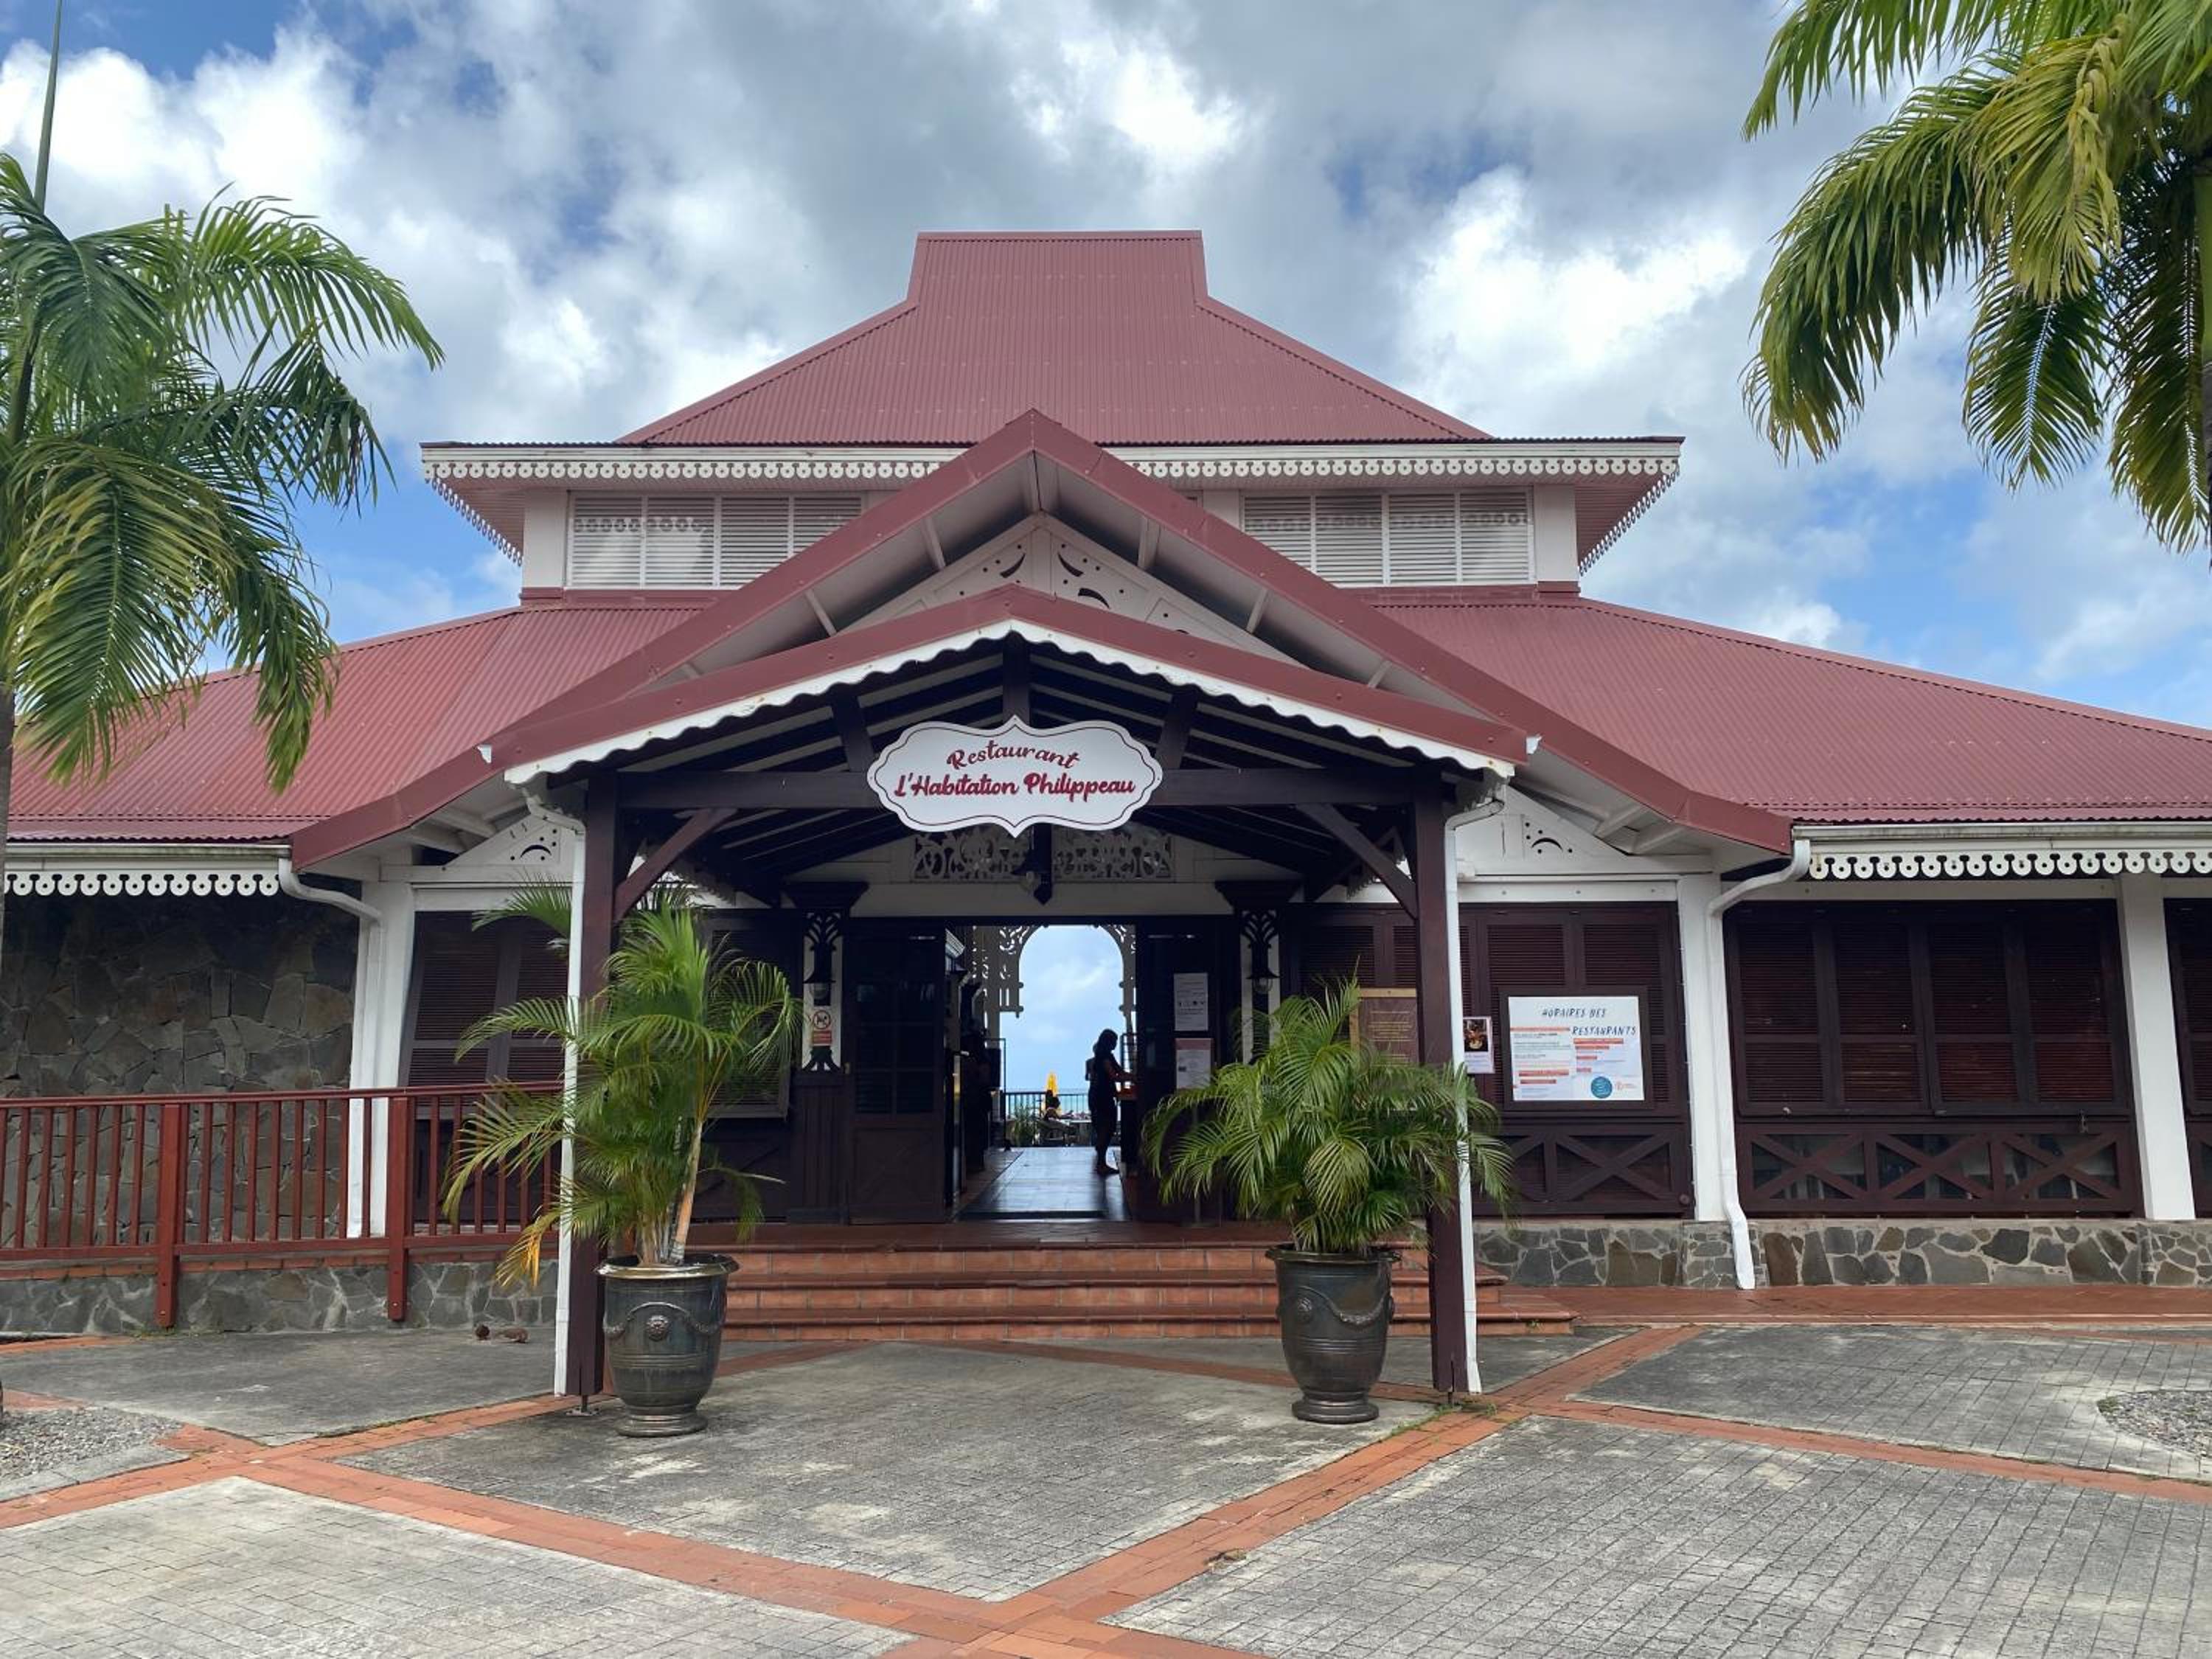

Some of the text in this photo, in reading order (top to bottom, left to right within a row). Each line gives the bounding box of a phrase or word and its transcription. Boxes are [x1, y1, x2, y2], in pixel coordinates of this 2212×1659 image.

[947, 740, 1080, 770] Restaurant
[894, 772, 1136, 803] L'Habitation Philippeau
